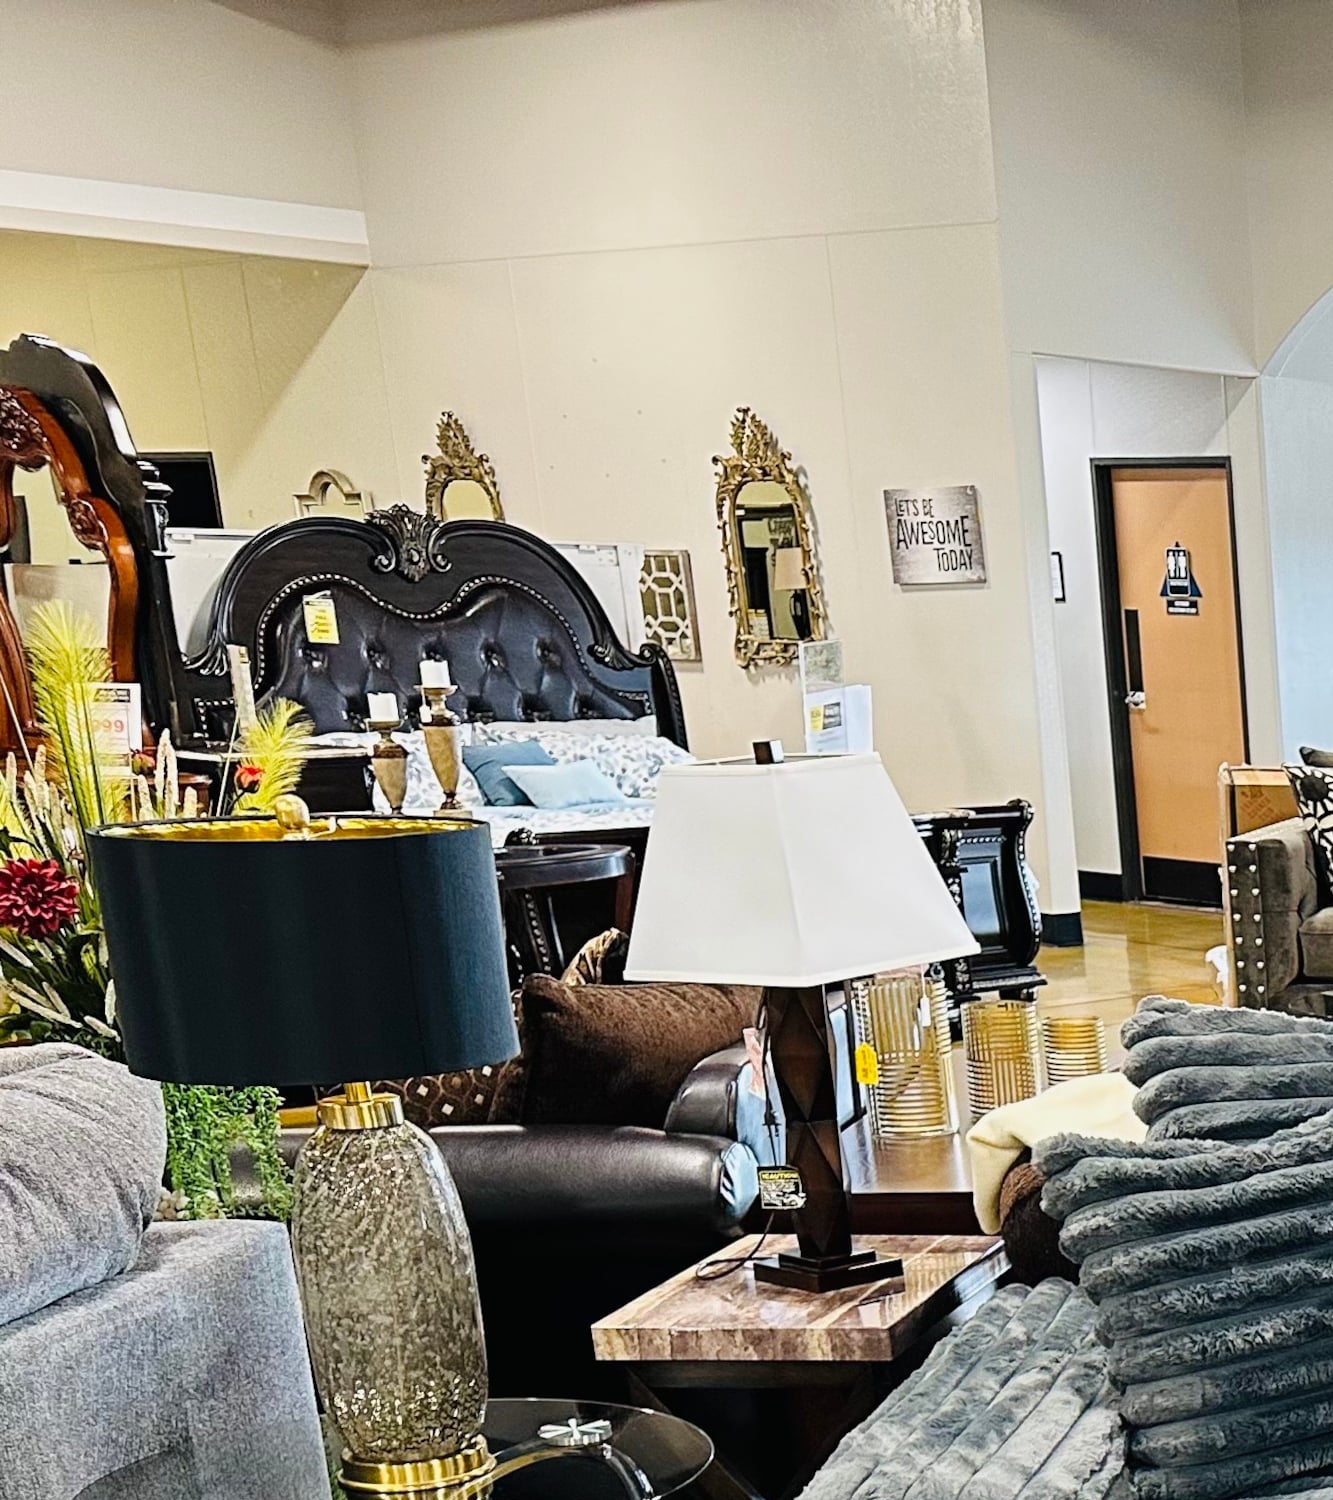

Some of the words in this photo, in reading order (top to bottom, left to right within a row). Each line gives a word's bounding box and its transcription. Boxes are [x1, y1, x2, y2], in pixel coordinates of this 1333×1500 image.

[894, 497, 920, 517] LET'S
[922, 498, 935, 518] BE
[895, 515, 973, 551] AWESOME
[932, 547, 974, 573] TODAY
